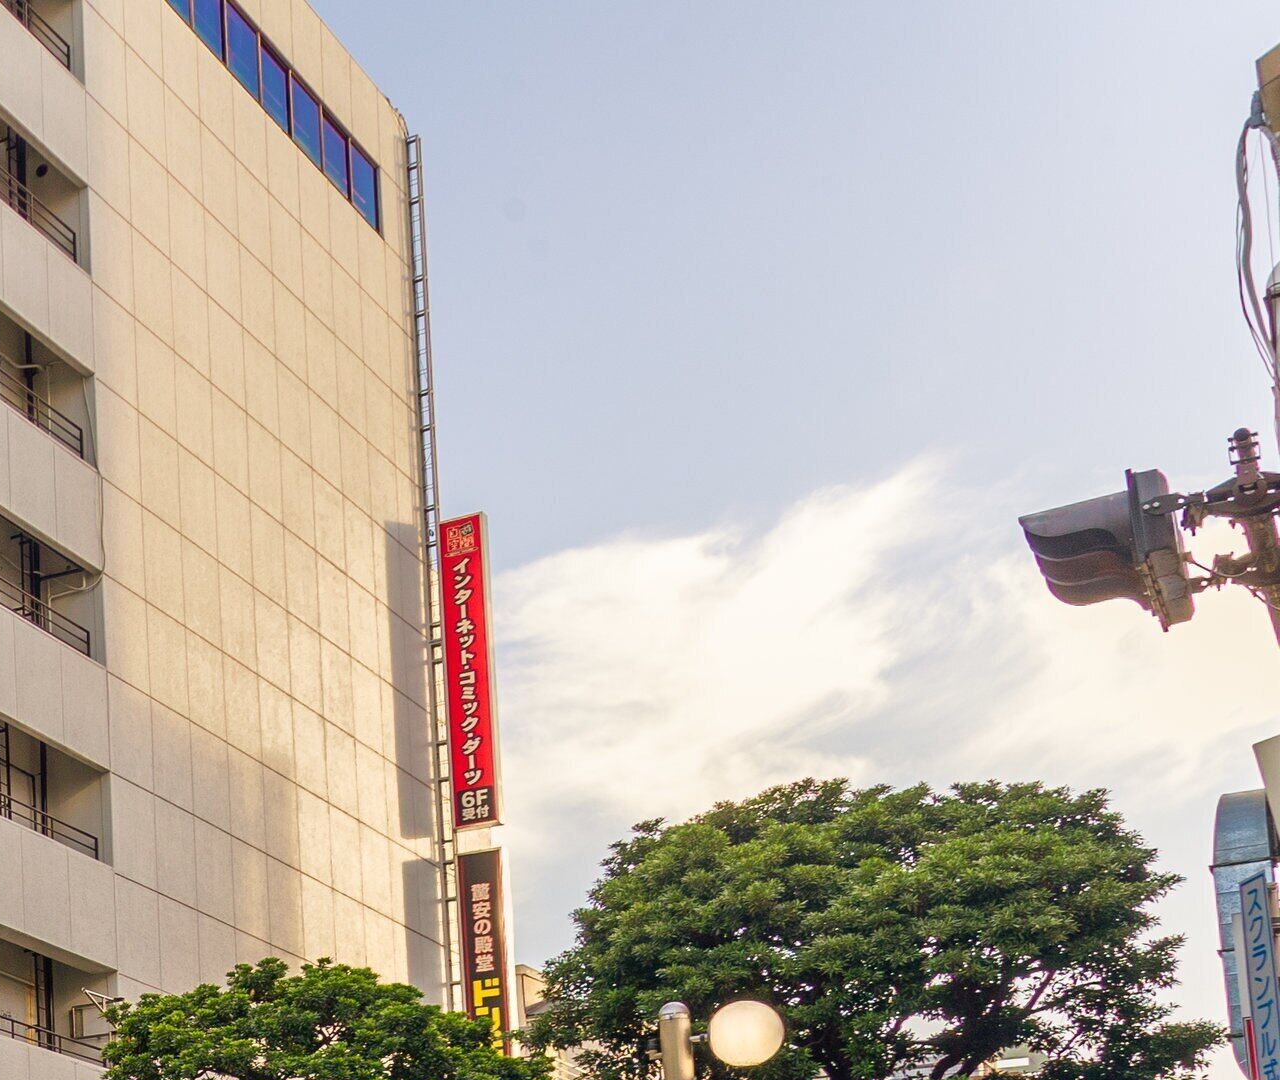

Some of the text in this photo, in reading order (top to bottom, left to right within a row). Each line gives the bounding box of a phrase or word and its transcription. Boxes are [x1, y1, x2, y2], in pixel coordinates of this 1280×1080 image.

[461, 788, 488, 808] 6F
[462, 805, 489, 821] 受付
[470, 883, 495, 973] 驚安の殿堂
